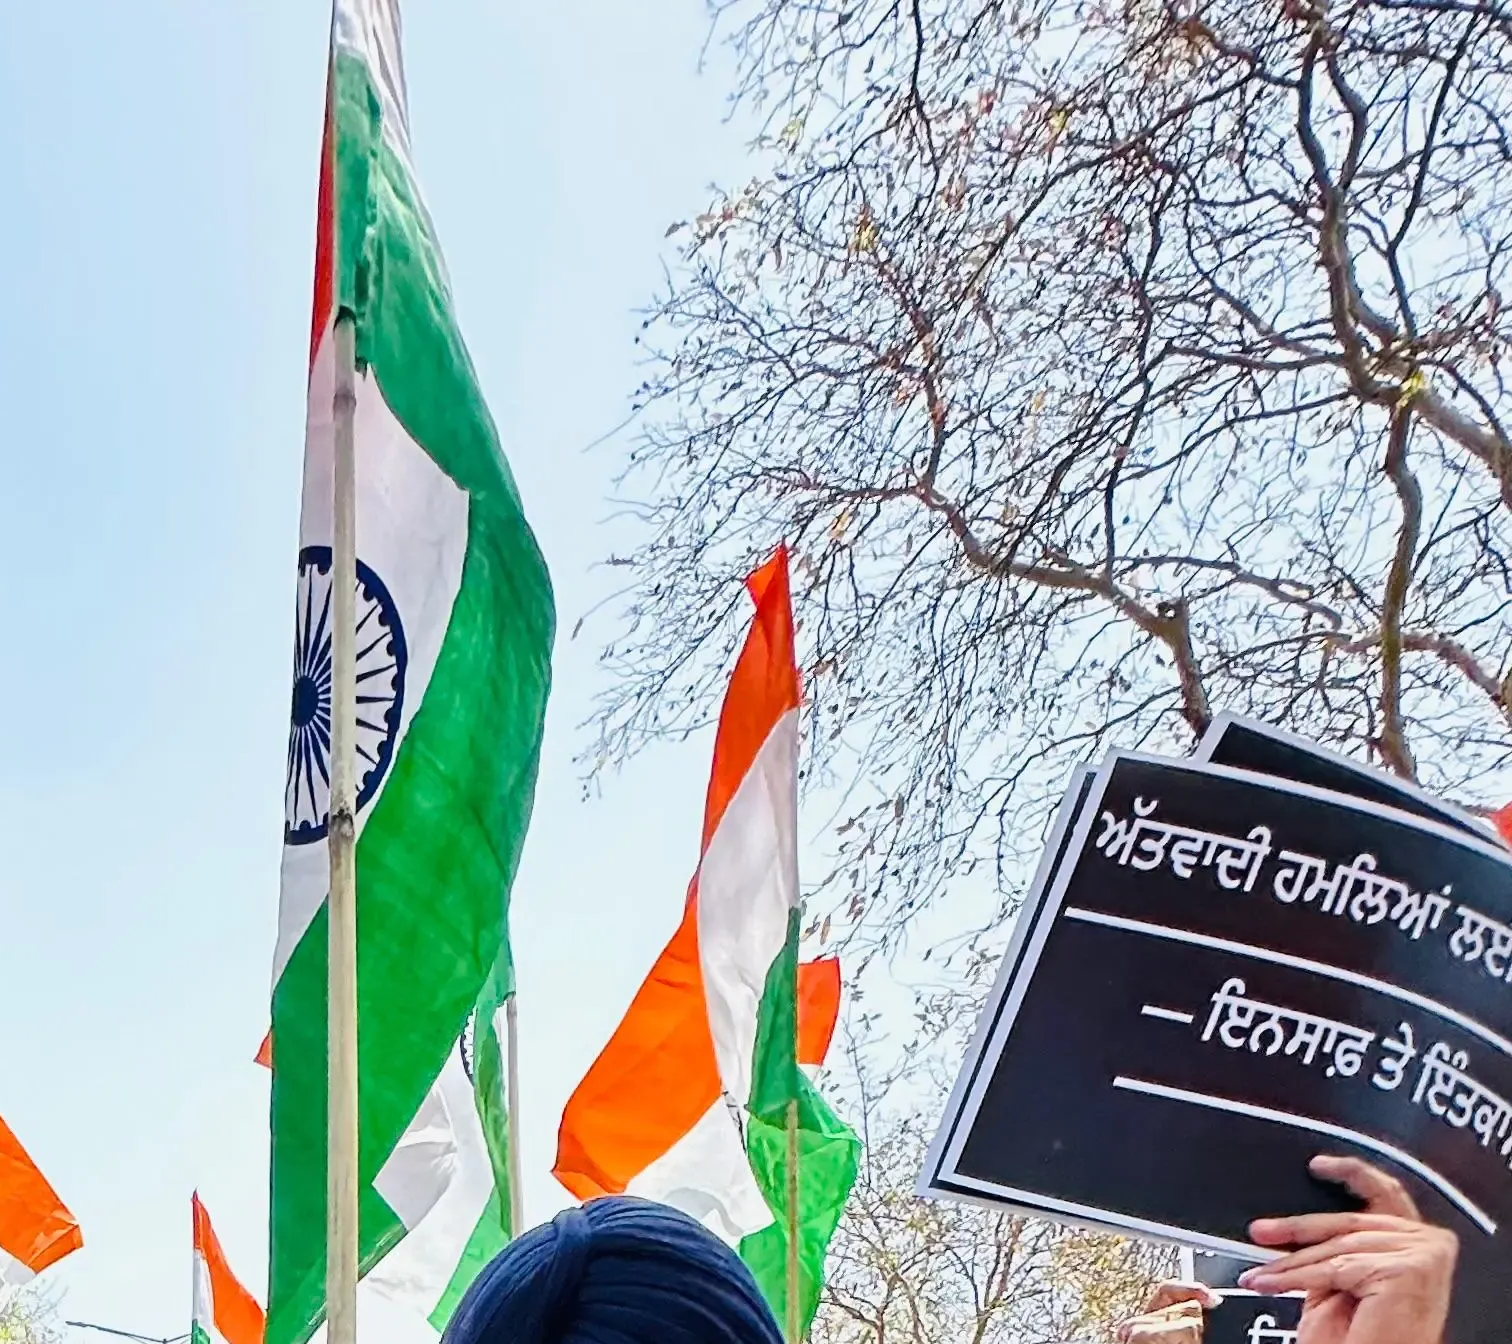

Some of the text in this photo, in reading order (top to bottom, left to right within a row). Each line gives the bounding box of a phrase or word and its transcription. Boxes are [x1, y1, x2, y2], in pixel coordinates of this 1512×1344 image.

[1095, 796, 1272, 892] ਅੱਤਵਾਦੀ
[1273, 849, 1452, 940] ਹਮਲਿਆਂ
[1201, 977, 1376, 1077] ਇਨਸਾਫ਼
[1372, 1022, 1417, 1090] ਤੇ
